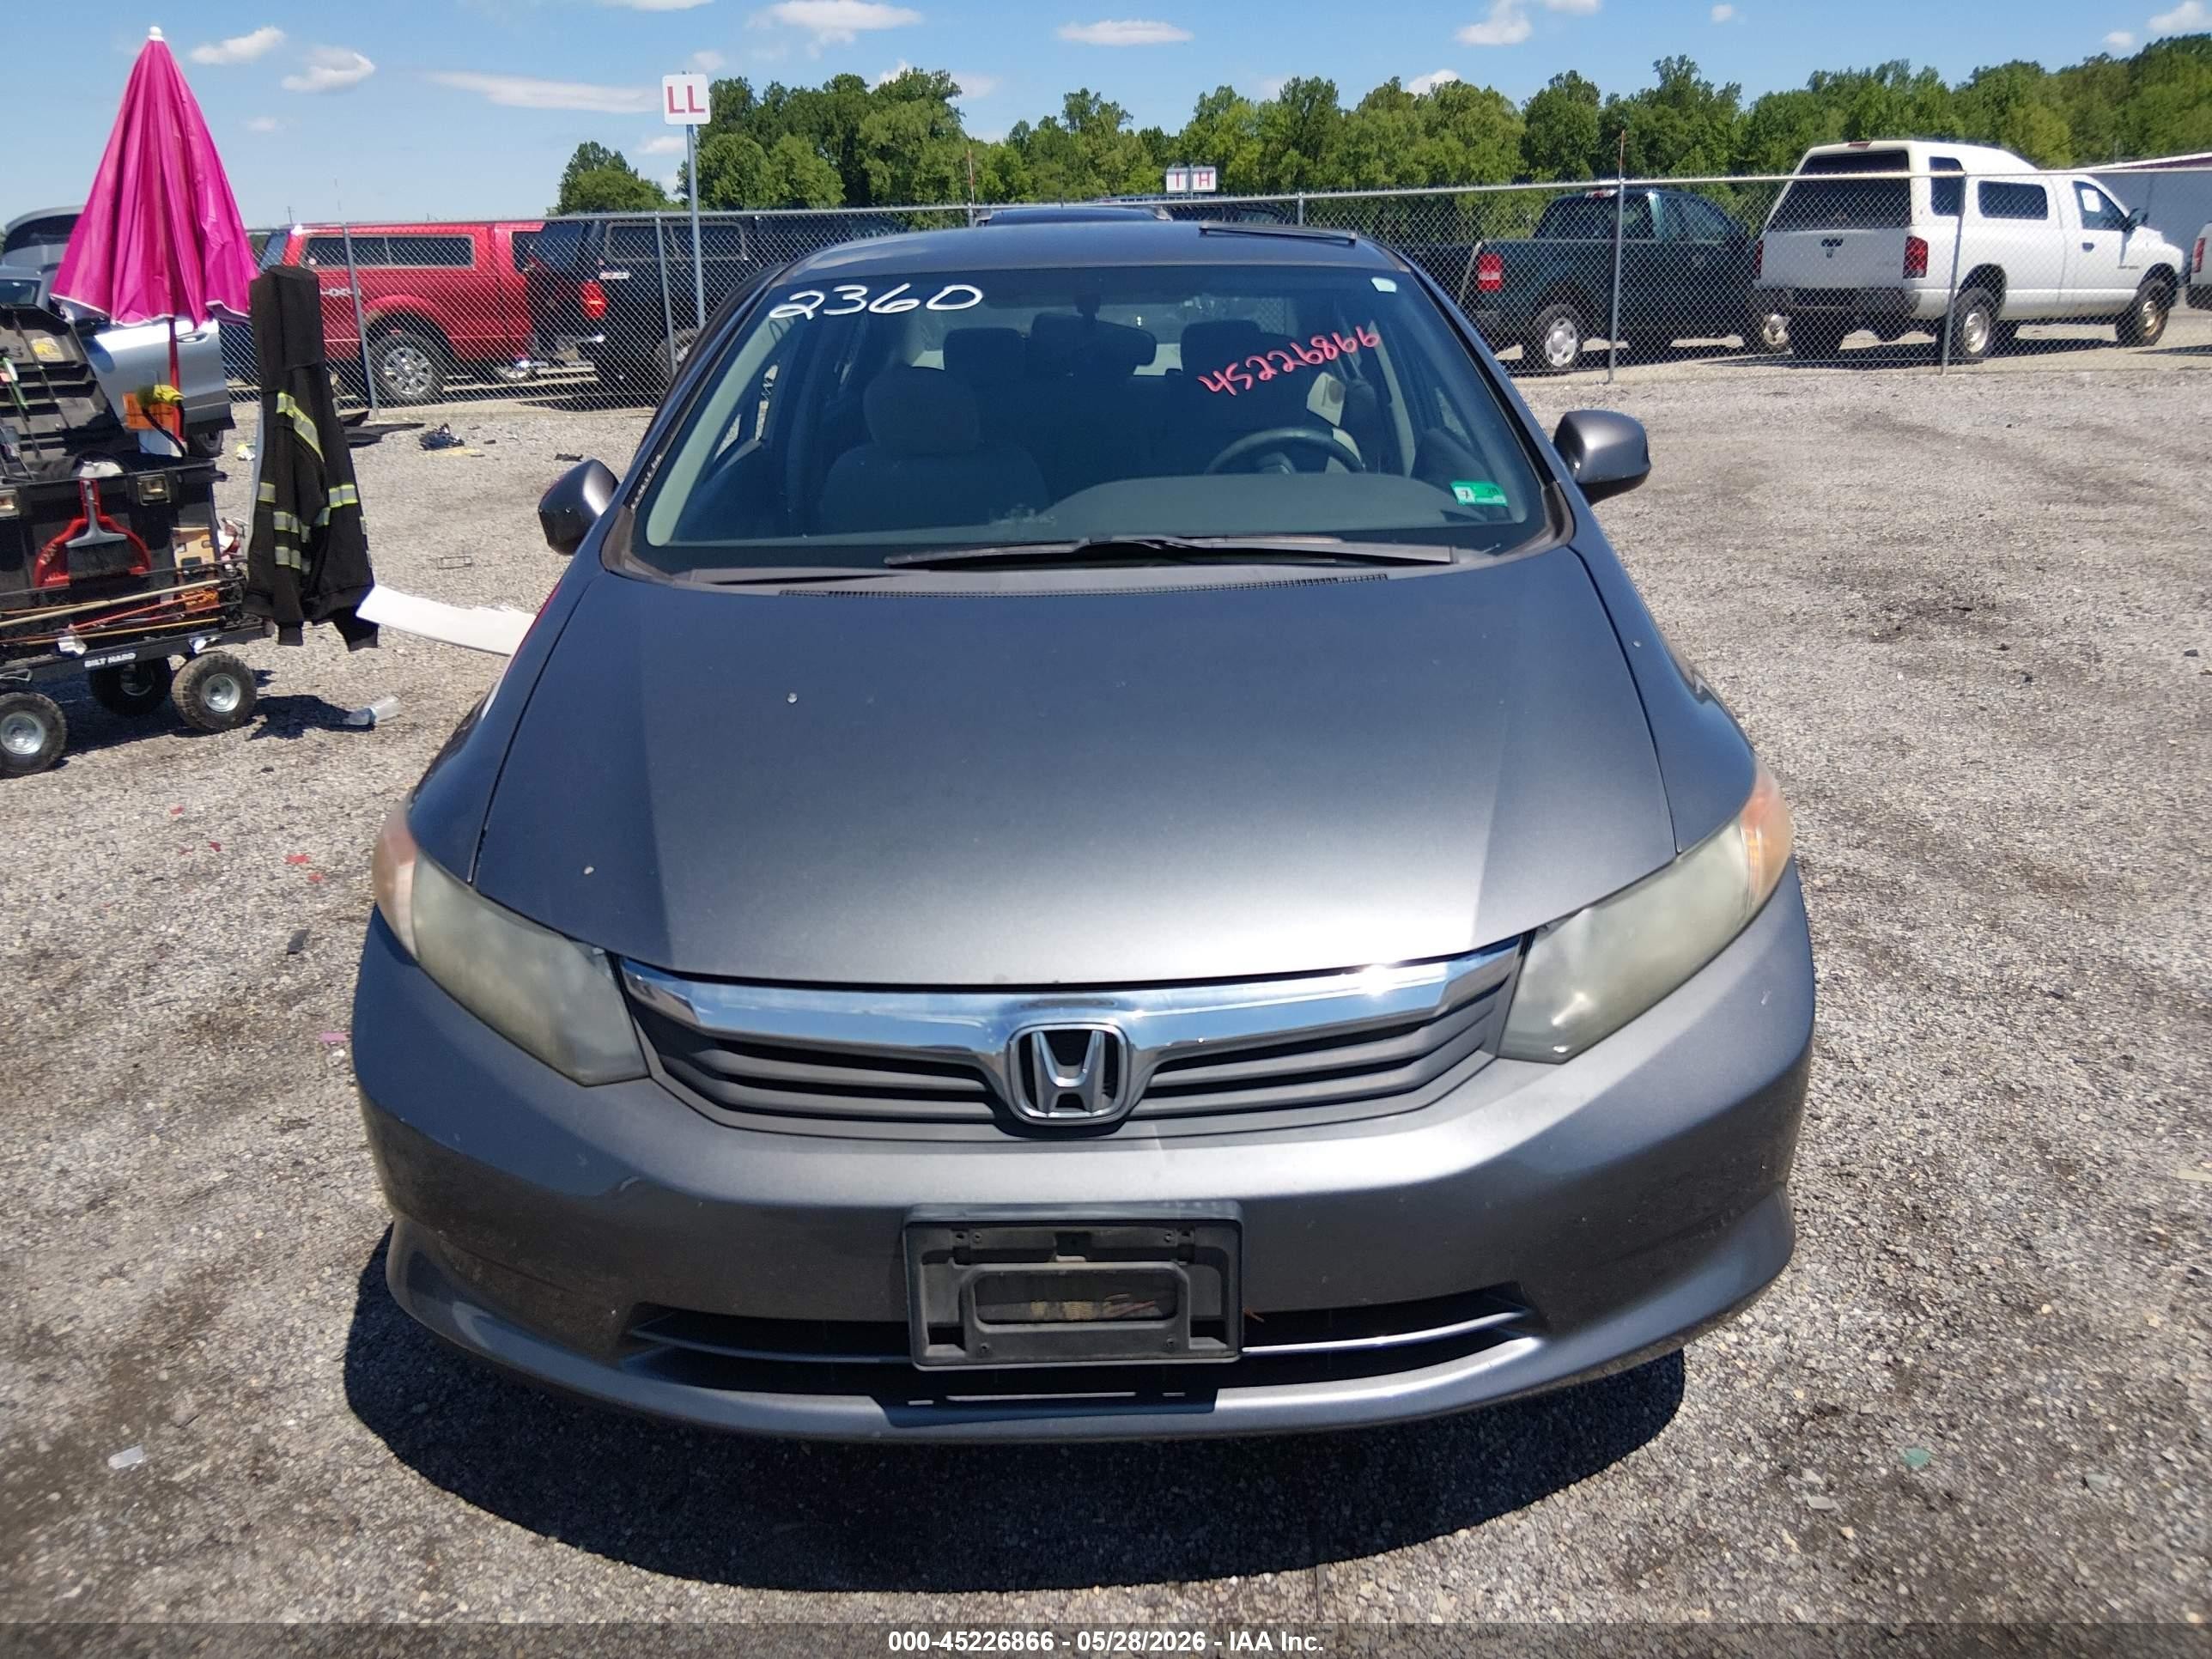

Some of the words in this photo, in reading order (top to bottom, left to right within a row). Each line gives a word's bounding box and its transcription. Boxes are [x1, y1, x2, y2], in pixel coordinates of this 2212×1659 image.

[667, 85, 705, 113] LL
[1199, 171, 1210, 187] H
[769, 283, 983, 320] 2360
[1198, 325, 1380, 396] 45226866
